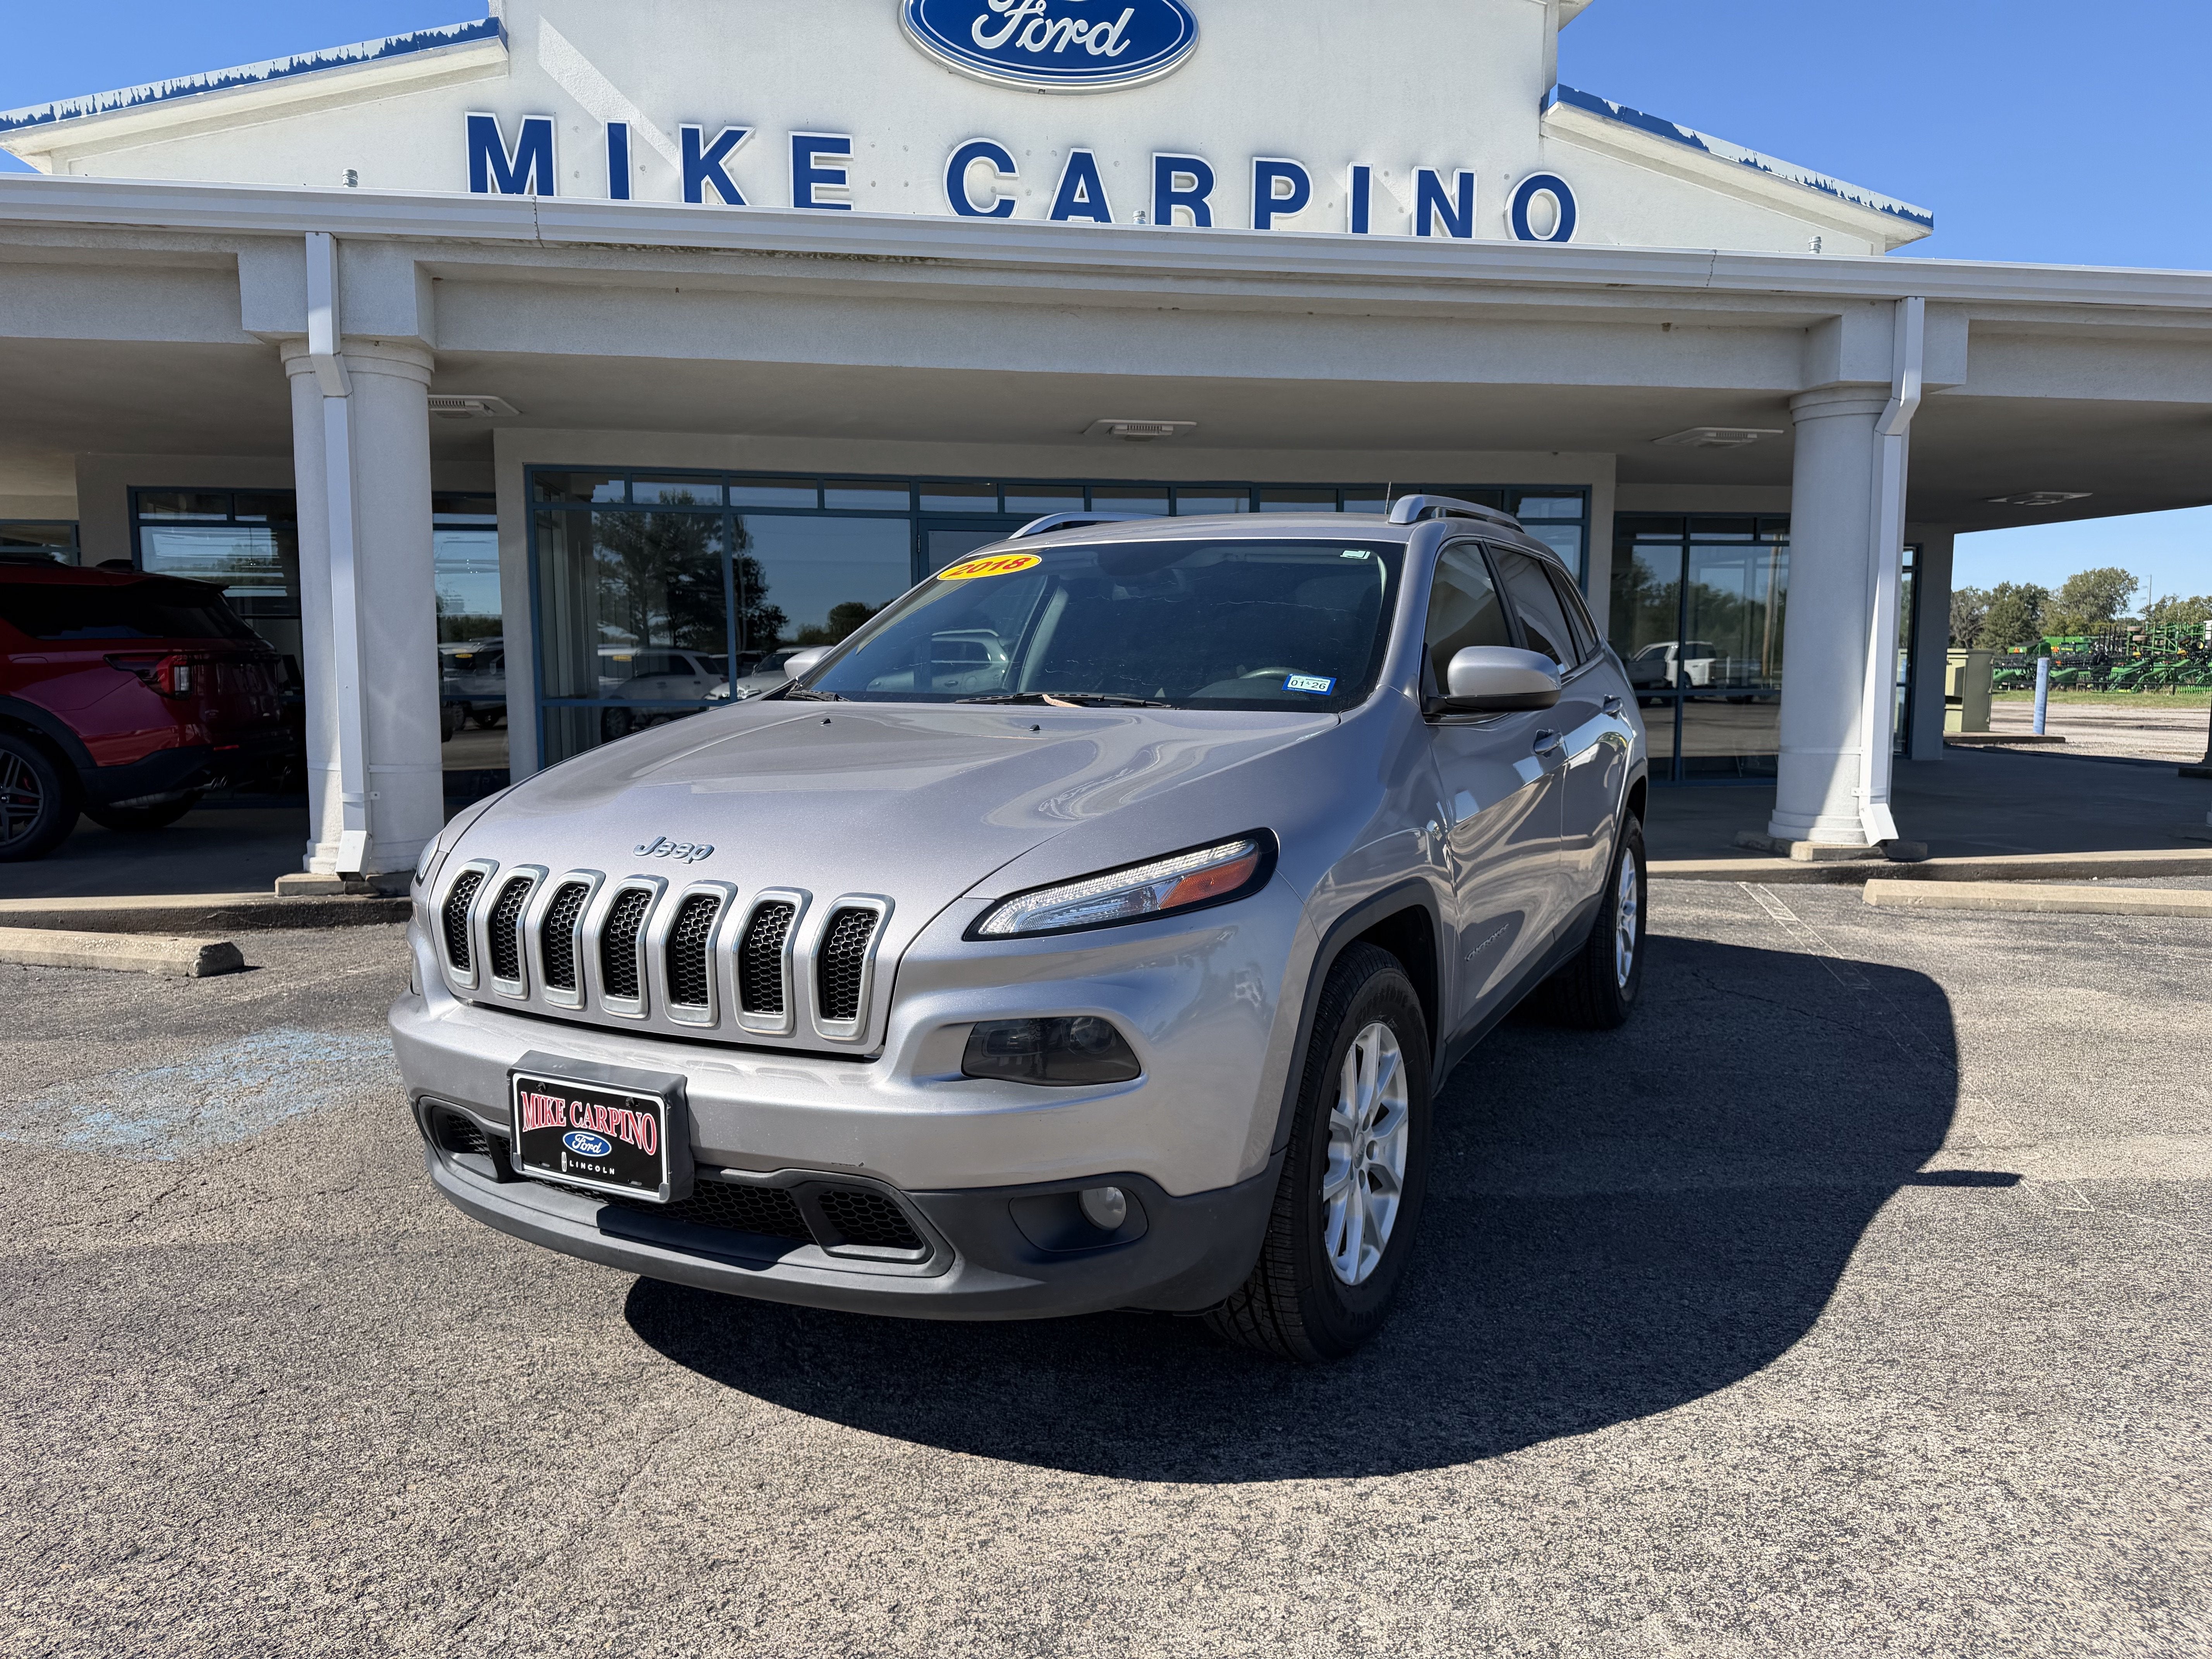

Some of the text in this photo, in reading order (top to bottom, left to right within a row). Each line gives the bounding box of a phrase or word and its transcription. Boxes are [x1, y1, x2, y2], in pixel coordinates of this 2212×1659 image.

[972, 0, 1135, 57] Ford
[464, 112, 1579, 243] MIKE CARPINO
[945, 557, 1032, 578] 2018
[633, 836, 714, 864] Jeep
[520, 1091, 657, 1156] MIKE CARPINO
[572, 1133, 601, 1154] Ford
[569, 1159, 615, 1175] LINCOLN
